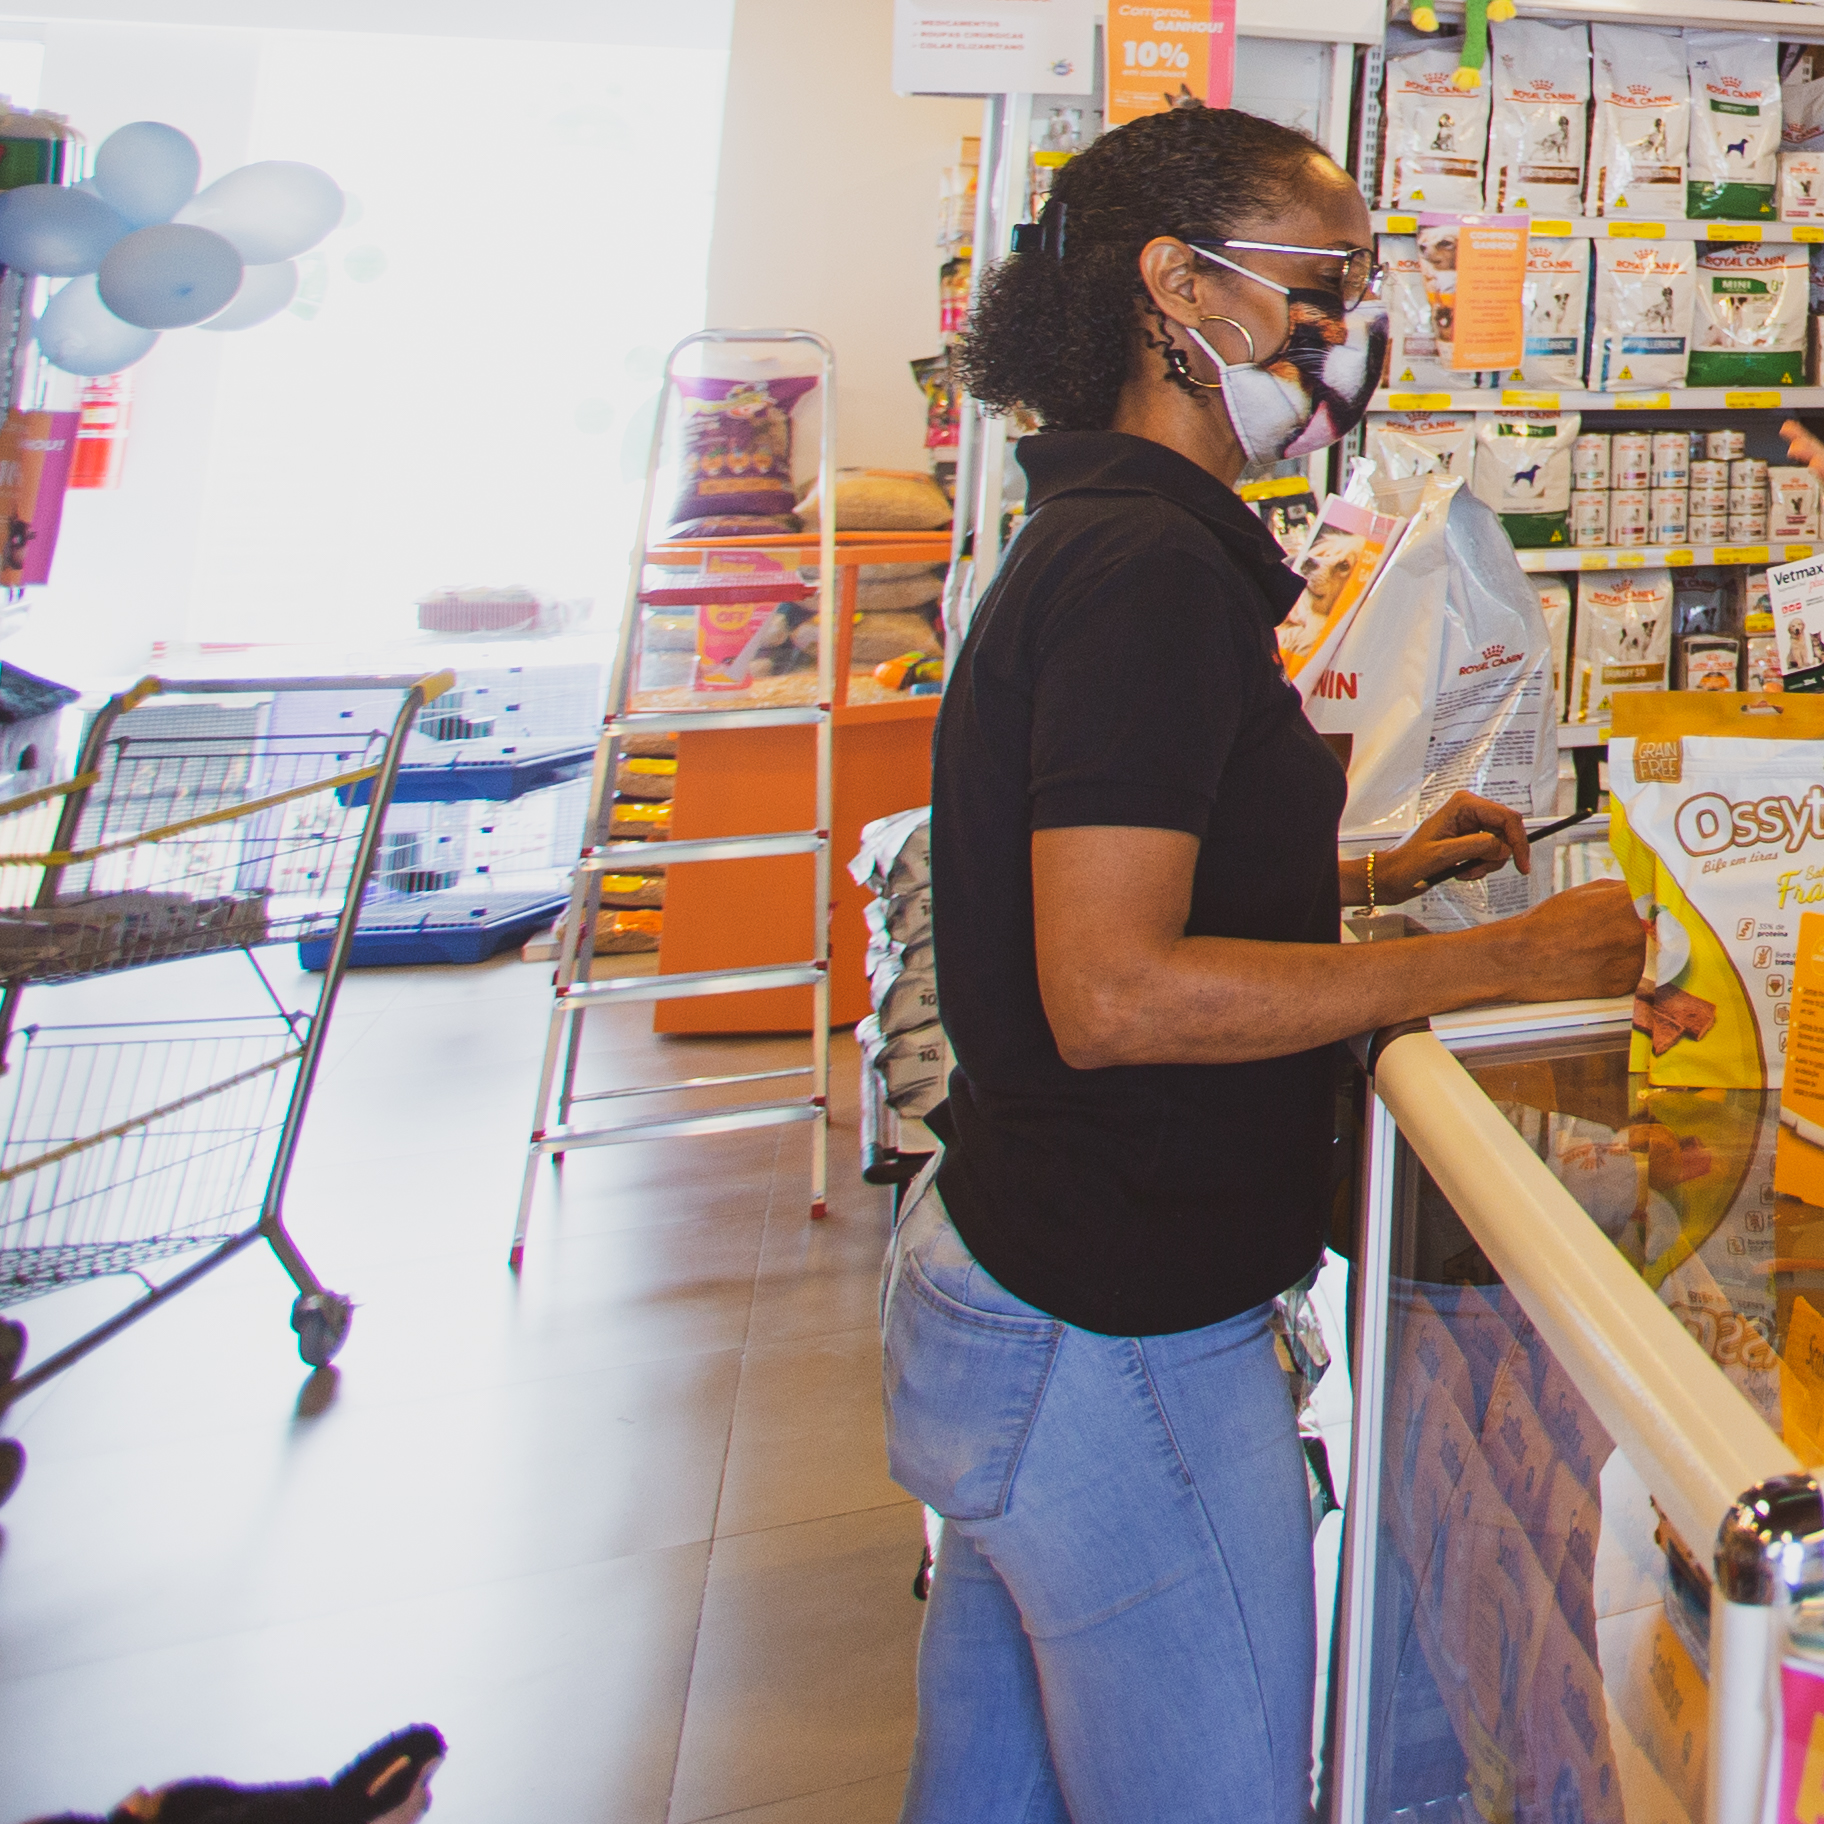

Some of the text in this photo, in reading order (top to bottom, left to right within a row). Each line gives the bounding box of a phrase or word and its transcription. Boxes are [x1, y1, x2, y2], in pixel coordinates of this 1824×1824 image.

[1153, 19, 1225, 34] GANHOU!
[1122, 40, 1190, 68] 10%
[1512, 89, 1576, 101] ROYAL CANIN
[1706, 83, 1762, 99] ROYAL CANIN
[1705, 254, 1786, 267] ROYAL CANIN
[1722, 279, 1751, 289] MINI
[1459, 660, 1490, 676] ROYAL
[1638, 741, 1679, 759] GRAIN
[1639, 758, 1678, 778] FREE
[1702, 858, 1727, 874] Bife
[1749, 851, 1779, 864] tiras
